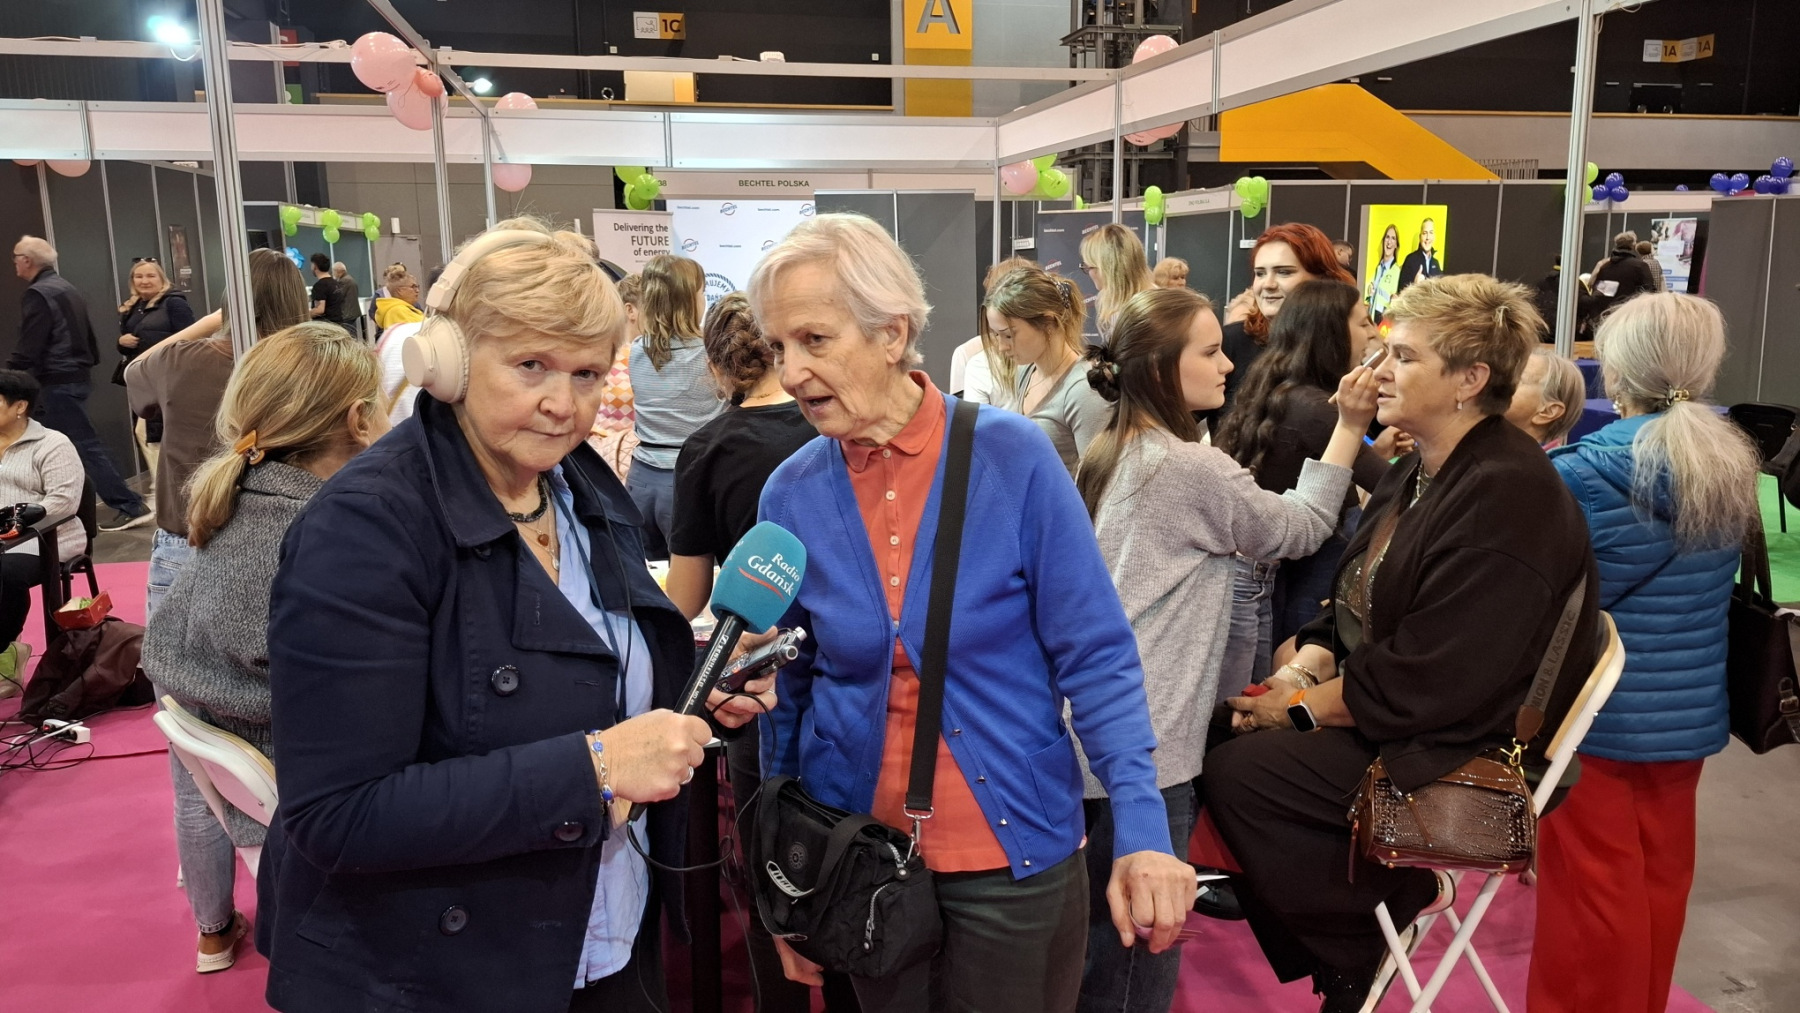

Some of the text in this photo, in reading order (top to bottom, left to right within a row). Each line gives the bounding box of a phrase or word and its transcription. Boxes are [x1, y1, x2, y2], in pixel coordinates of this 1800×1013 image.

[916, 0, 961, 34] A
[662, 18, 681, 33] 1C
[1663, 45, 1677, 57] 1A
[1698, 40, 1711, 53] 1A
[613, 222, 669, 234] Delivering the
[631, 235, 669, 246] FUTURE
[633, 247, 642, 256] of
[771, 552, 800, 582] Radio
[747, 554, 794, 597] Gdańsk
